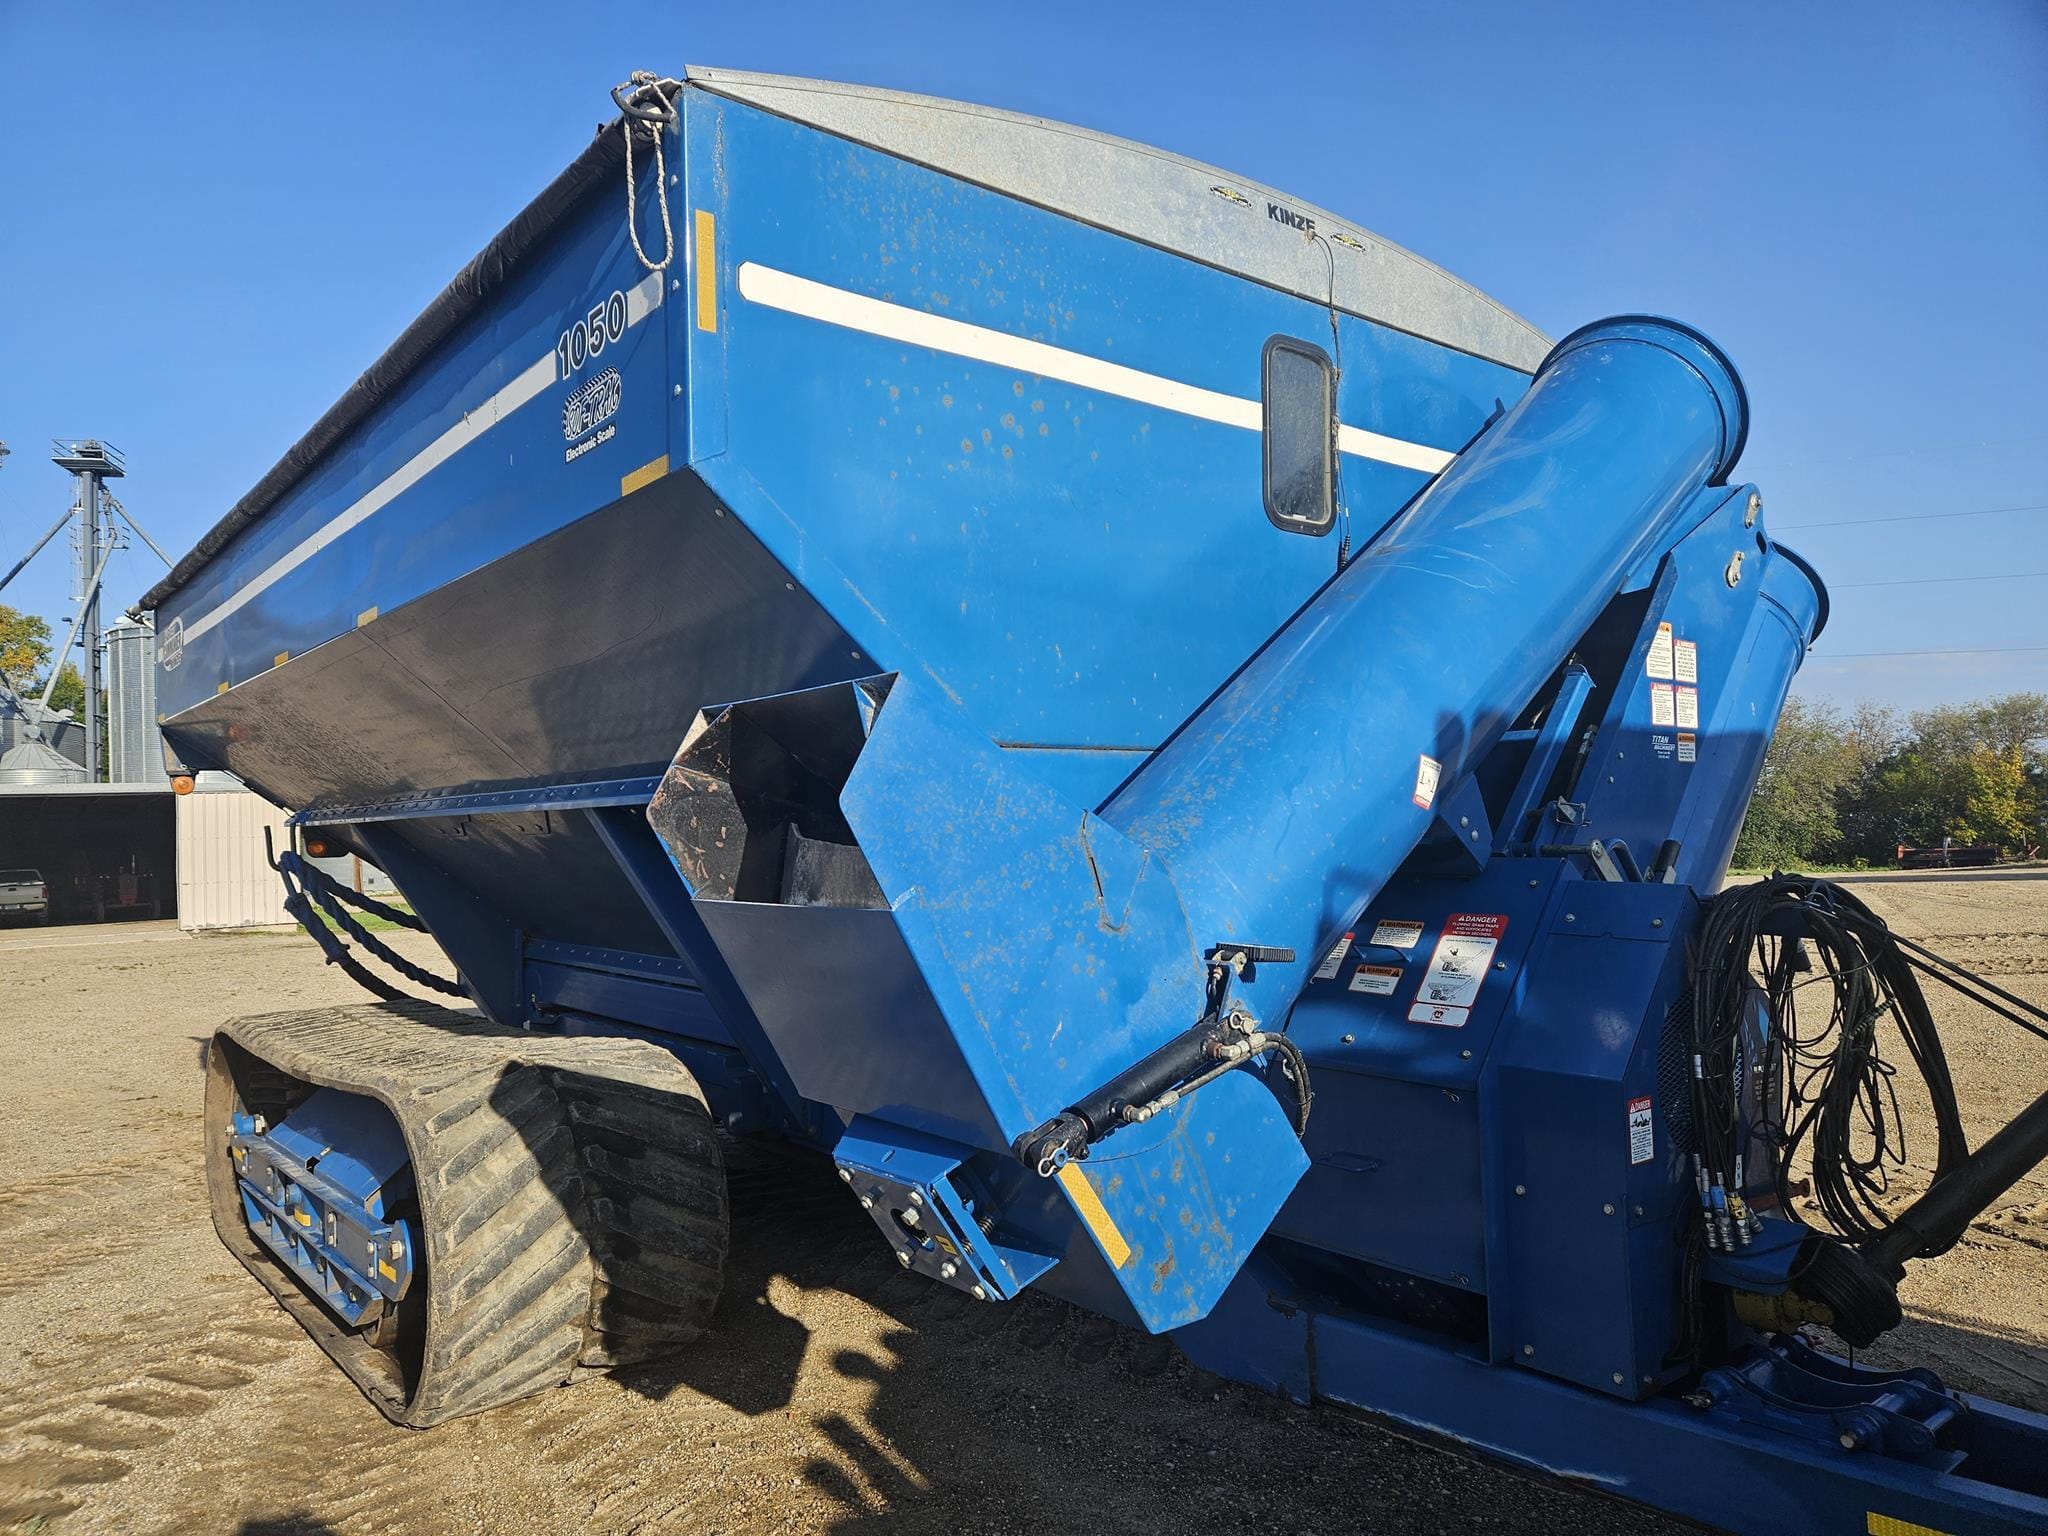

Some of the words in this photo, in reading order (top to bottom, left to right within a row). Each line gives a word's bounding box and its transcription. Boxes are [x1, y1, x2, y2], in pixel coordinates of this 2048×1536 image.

[557, 290, 626, 380] 1050
[565, 436, 597, 462] Electronic
[597, 424, 616, 445] Scale
[1652, 735, 1670, 743] TITAN
[1465, 915, 1498, 923] DANGER
